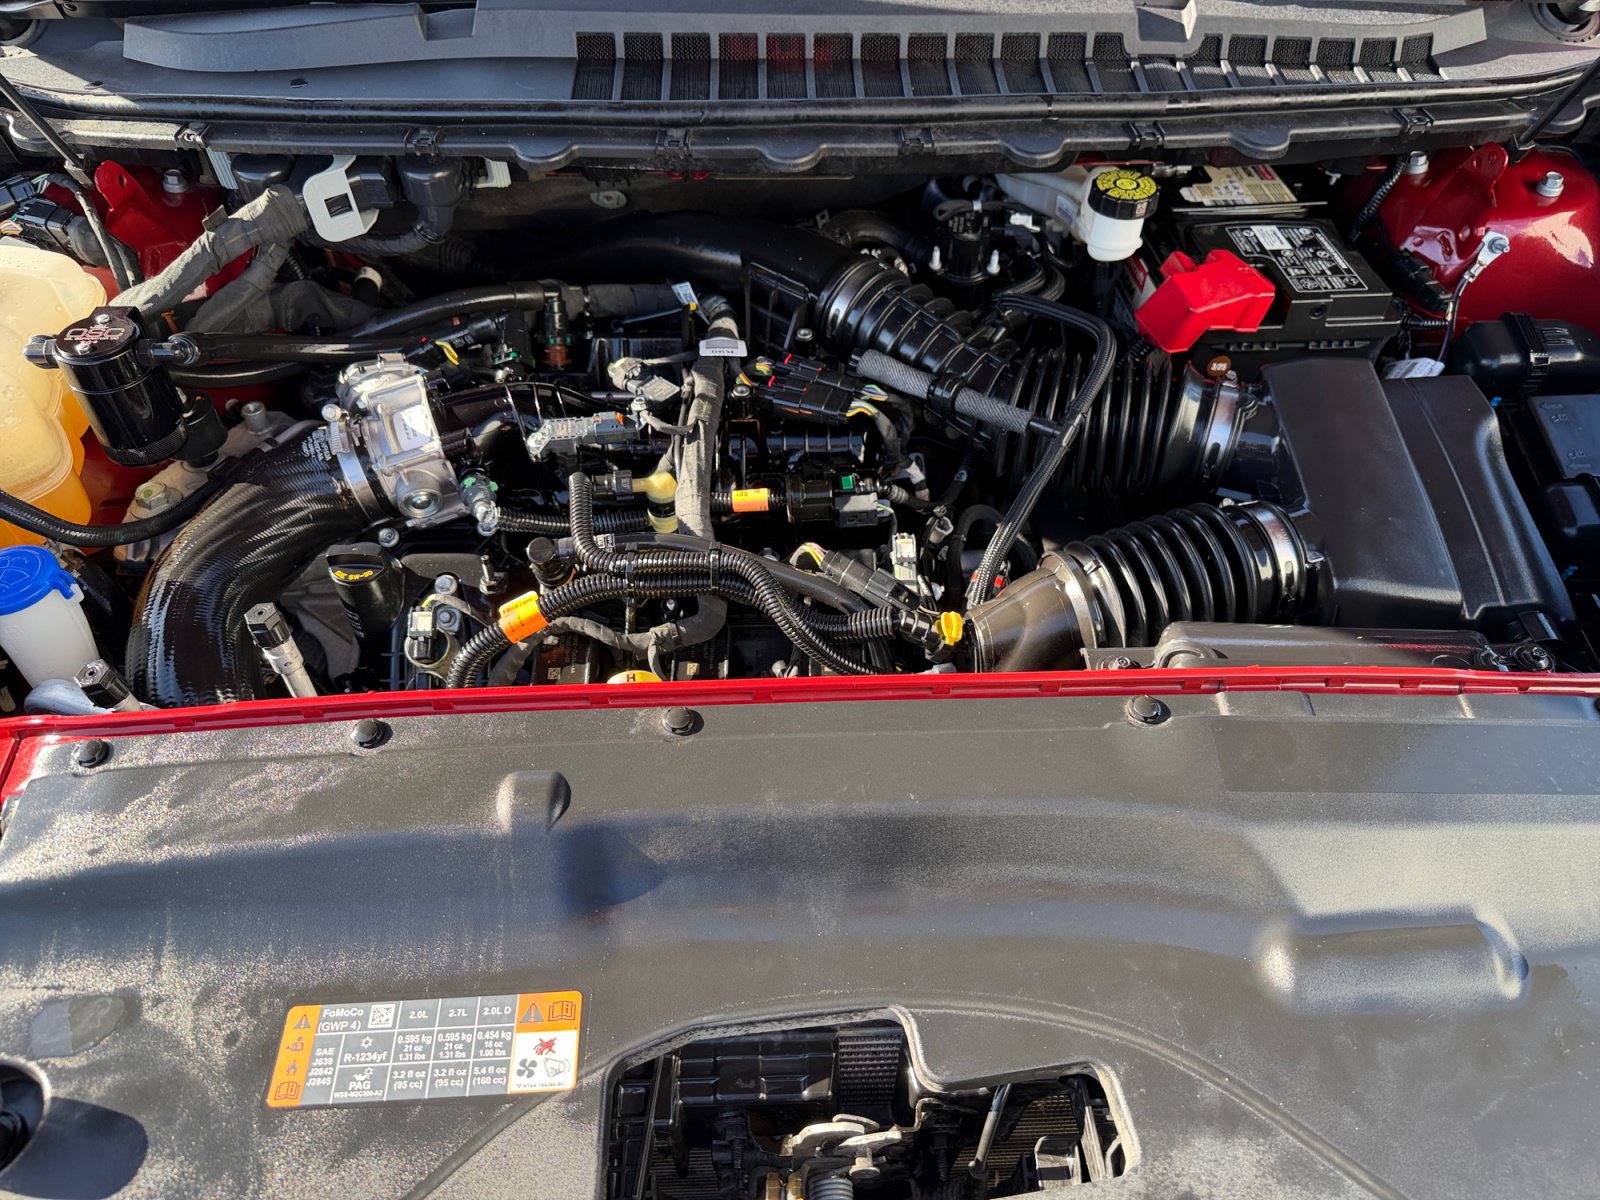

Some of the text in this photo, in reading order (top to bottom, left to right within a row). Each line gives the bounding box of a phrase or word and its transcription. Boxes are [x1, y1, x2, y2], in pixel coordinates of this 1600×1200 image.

[66, 328, 126, 338] OSC
[626, 673, 636, 682] H
[323, 1008, 364, 1018] FoMoCo
[448, 1009, 468, 1017] 2.7L
[504, 1006, 512, 1014] D
[409, 1011, 428, 1019] 2.0L
[318, 1020, 361, 1033] (GWP 4)
[397, 1035, 432, 1044] 0.595 kg
[438, 1033, 472, 1042] 0.595 kg
[477, 1031, 512, 1040] 0.454 kg
[316, 1048, 335, 1056] SAE
[344, 1051, 387, 1062] R-1234yf
[312, 1058, 333, 1066] J639
[308, 1067, 333, 1076] J2842
[392, 1070, 406, 1079] 3.2
[408, 1070, 413, 1078] fl
[434, 1068, 447, 1077] 3.2
[448, 1068, 454, 1076] fl
[474, 1067, 487, 1075] 5.4
[488, 1066, 494, 1074] fl
[306, 1077, 332, 1086] J2845
[348, 1081, 371, 1090] PAG
[394, 1080, 423, 1090] (95 cc)
[435, 1078, 464, 1089] (95 cc)
[472, 1077, 491, 1086] (160
[493, 1076, 506, 1085] cc)
